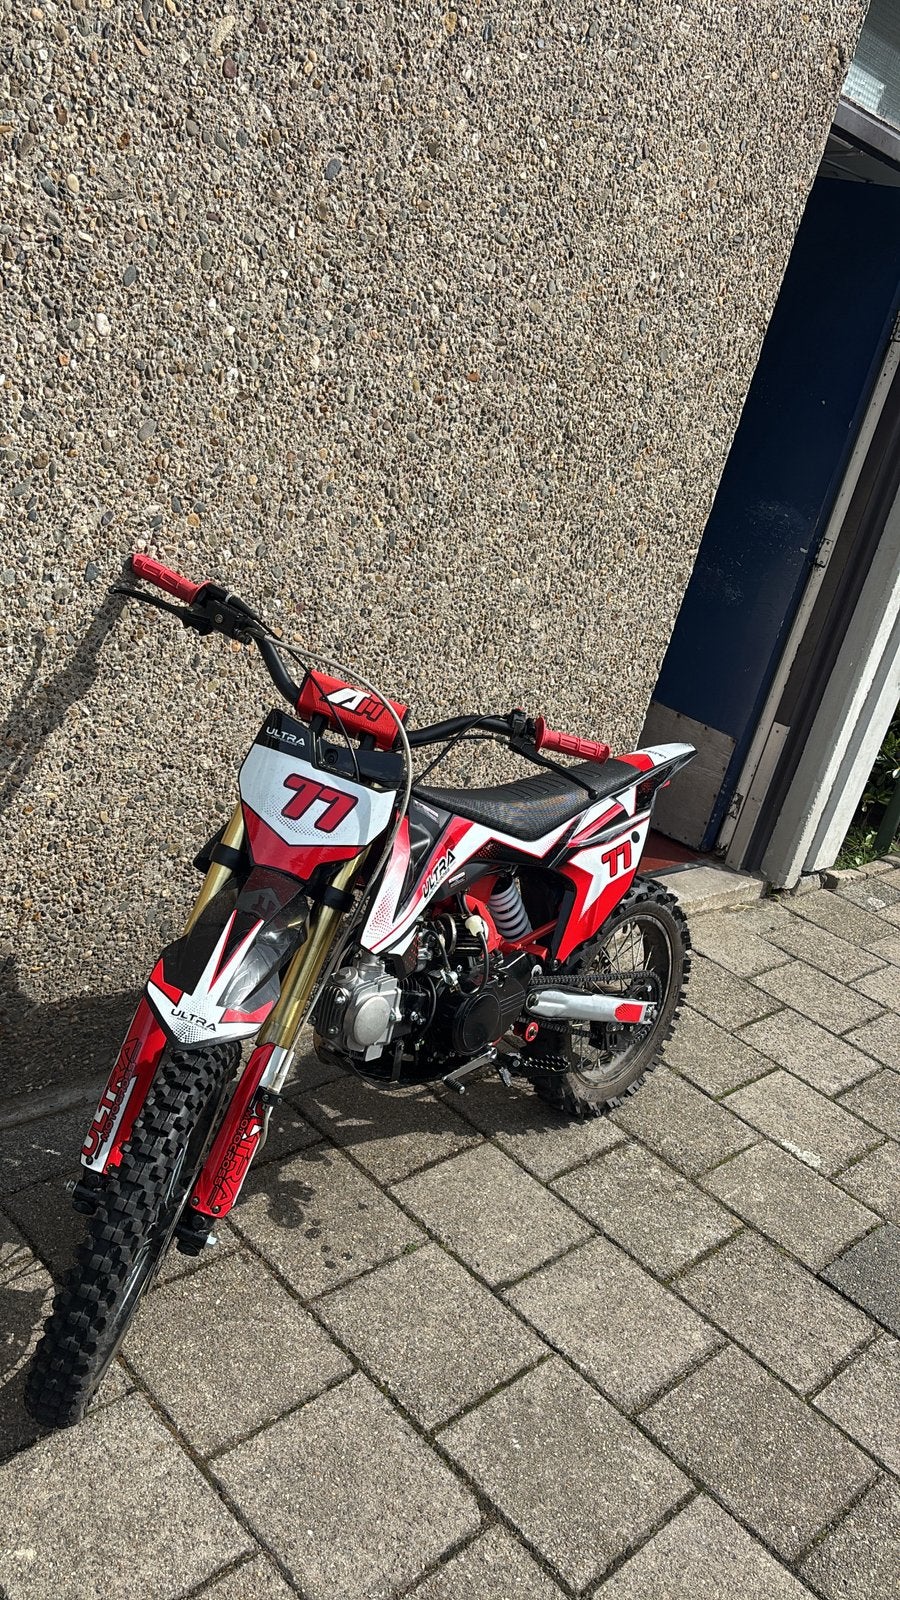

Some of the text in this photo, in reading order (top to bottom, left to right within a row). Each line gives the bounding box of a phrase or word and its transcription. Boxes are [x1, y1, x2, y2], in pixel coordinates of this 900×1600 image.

[266, 726, 306, 746] ULTRA
[283, 773, 359, 833] 77
[422, 850, 456, 898] ULTRA
[601, 839, 632, 878] 77
[171, 1008, 217, 1032] ULTRA
